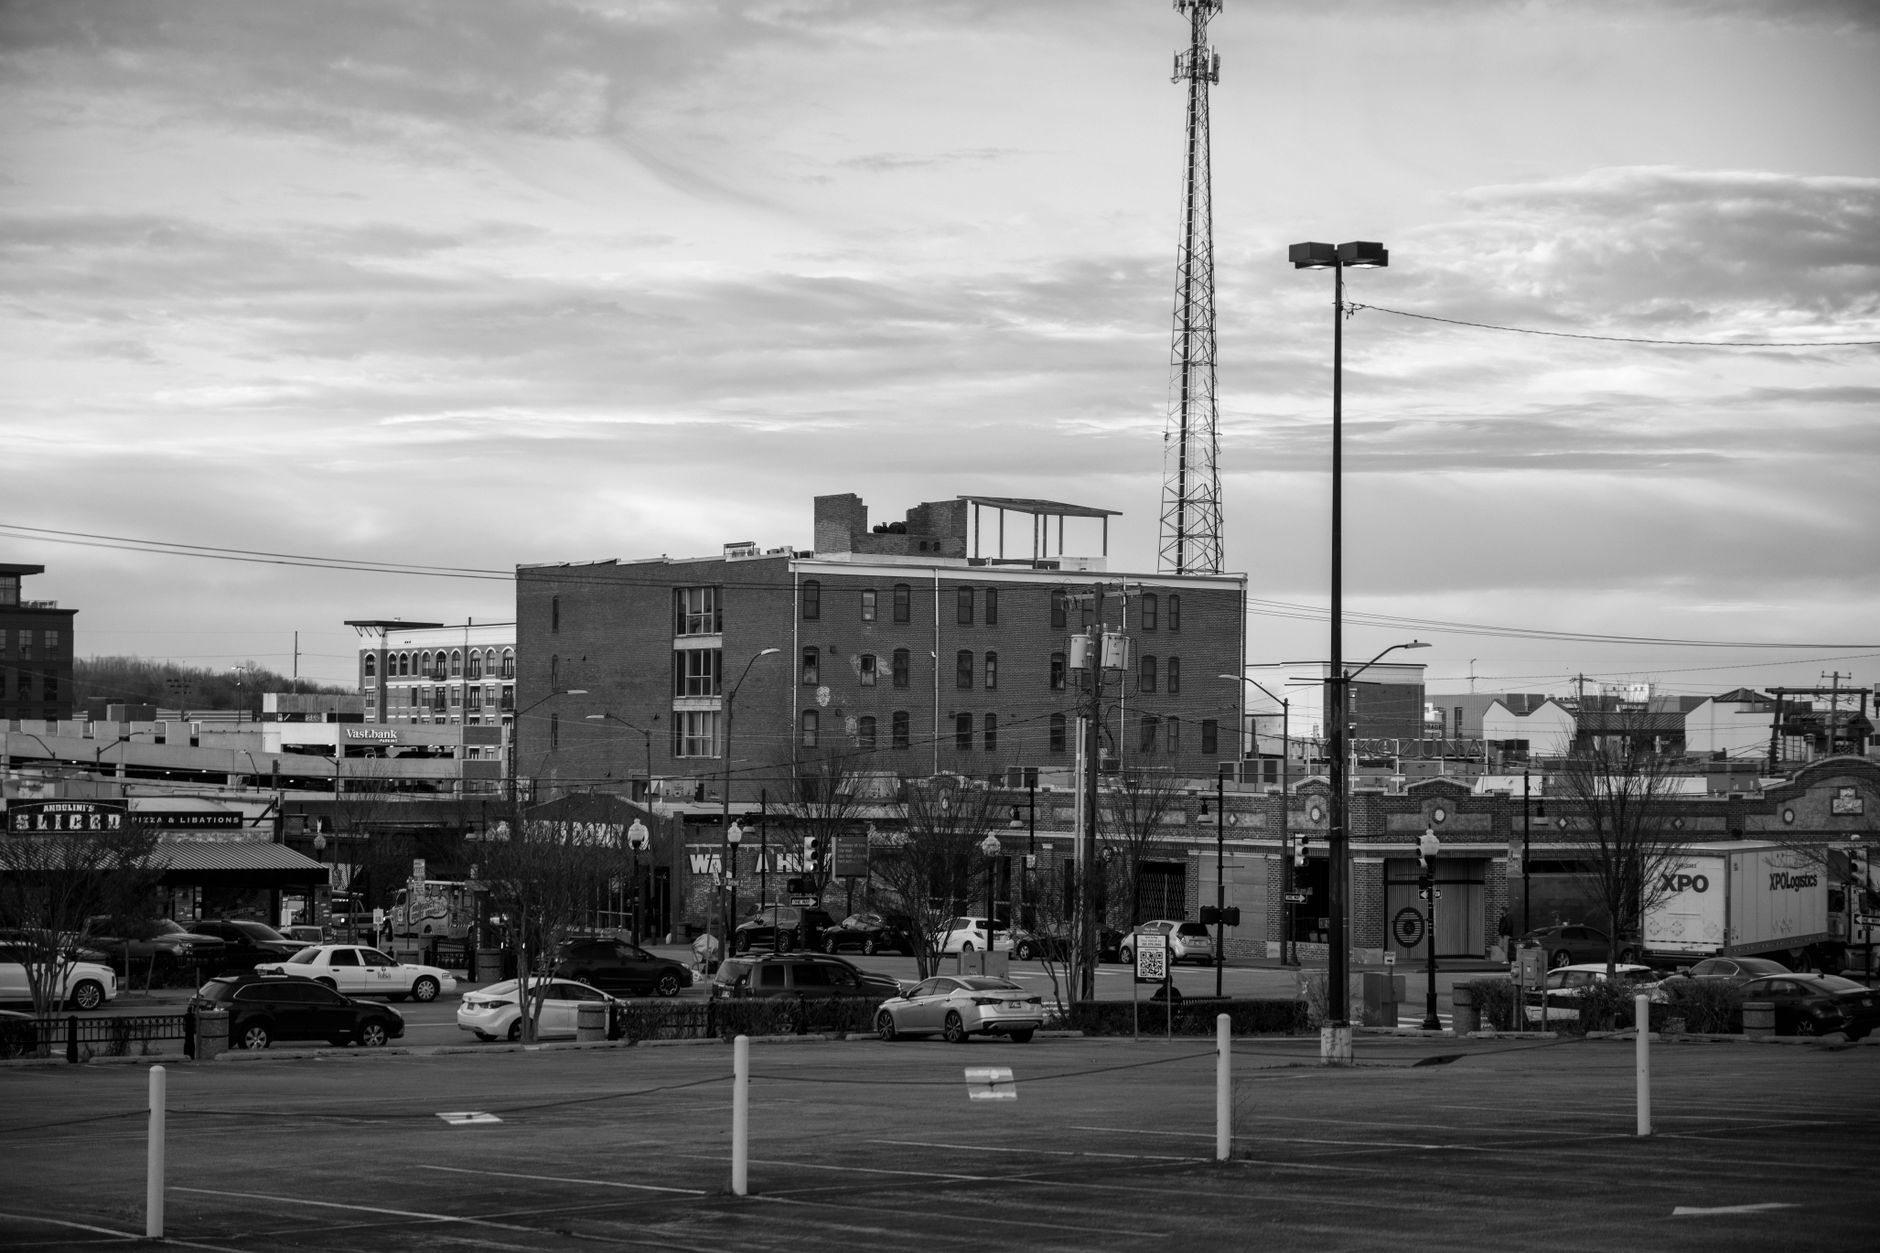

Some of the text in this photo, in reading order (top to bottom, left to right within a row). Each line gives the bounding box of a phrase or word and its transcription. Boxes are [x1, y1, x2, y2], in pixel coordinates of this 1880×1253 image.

[346, 728, 398, 739] Vast.bank
[1313, 738, 1485, 759] YKOZUNA
[43, 804, 96, 813] ANDOLINI'S
[16, 814, 121, 831] SLICED
[131, 816, 240, 824] PIZZA & LIBATIONS
[1661, 874, 1709, 893] XPO
